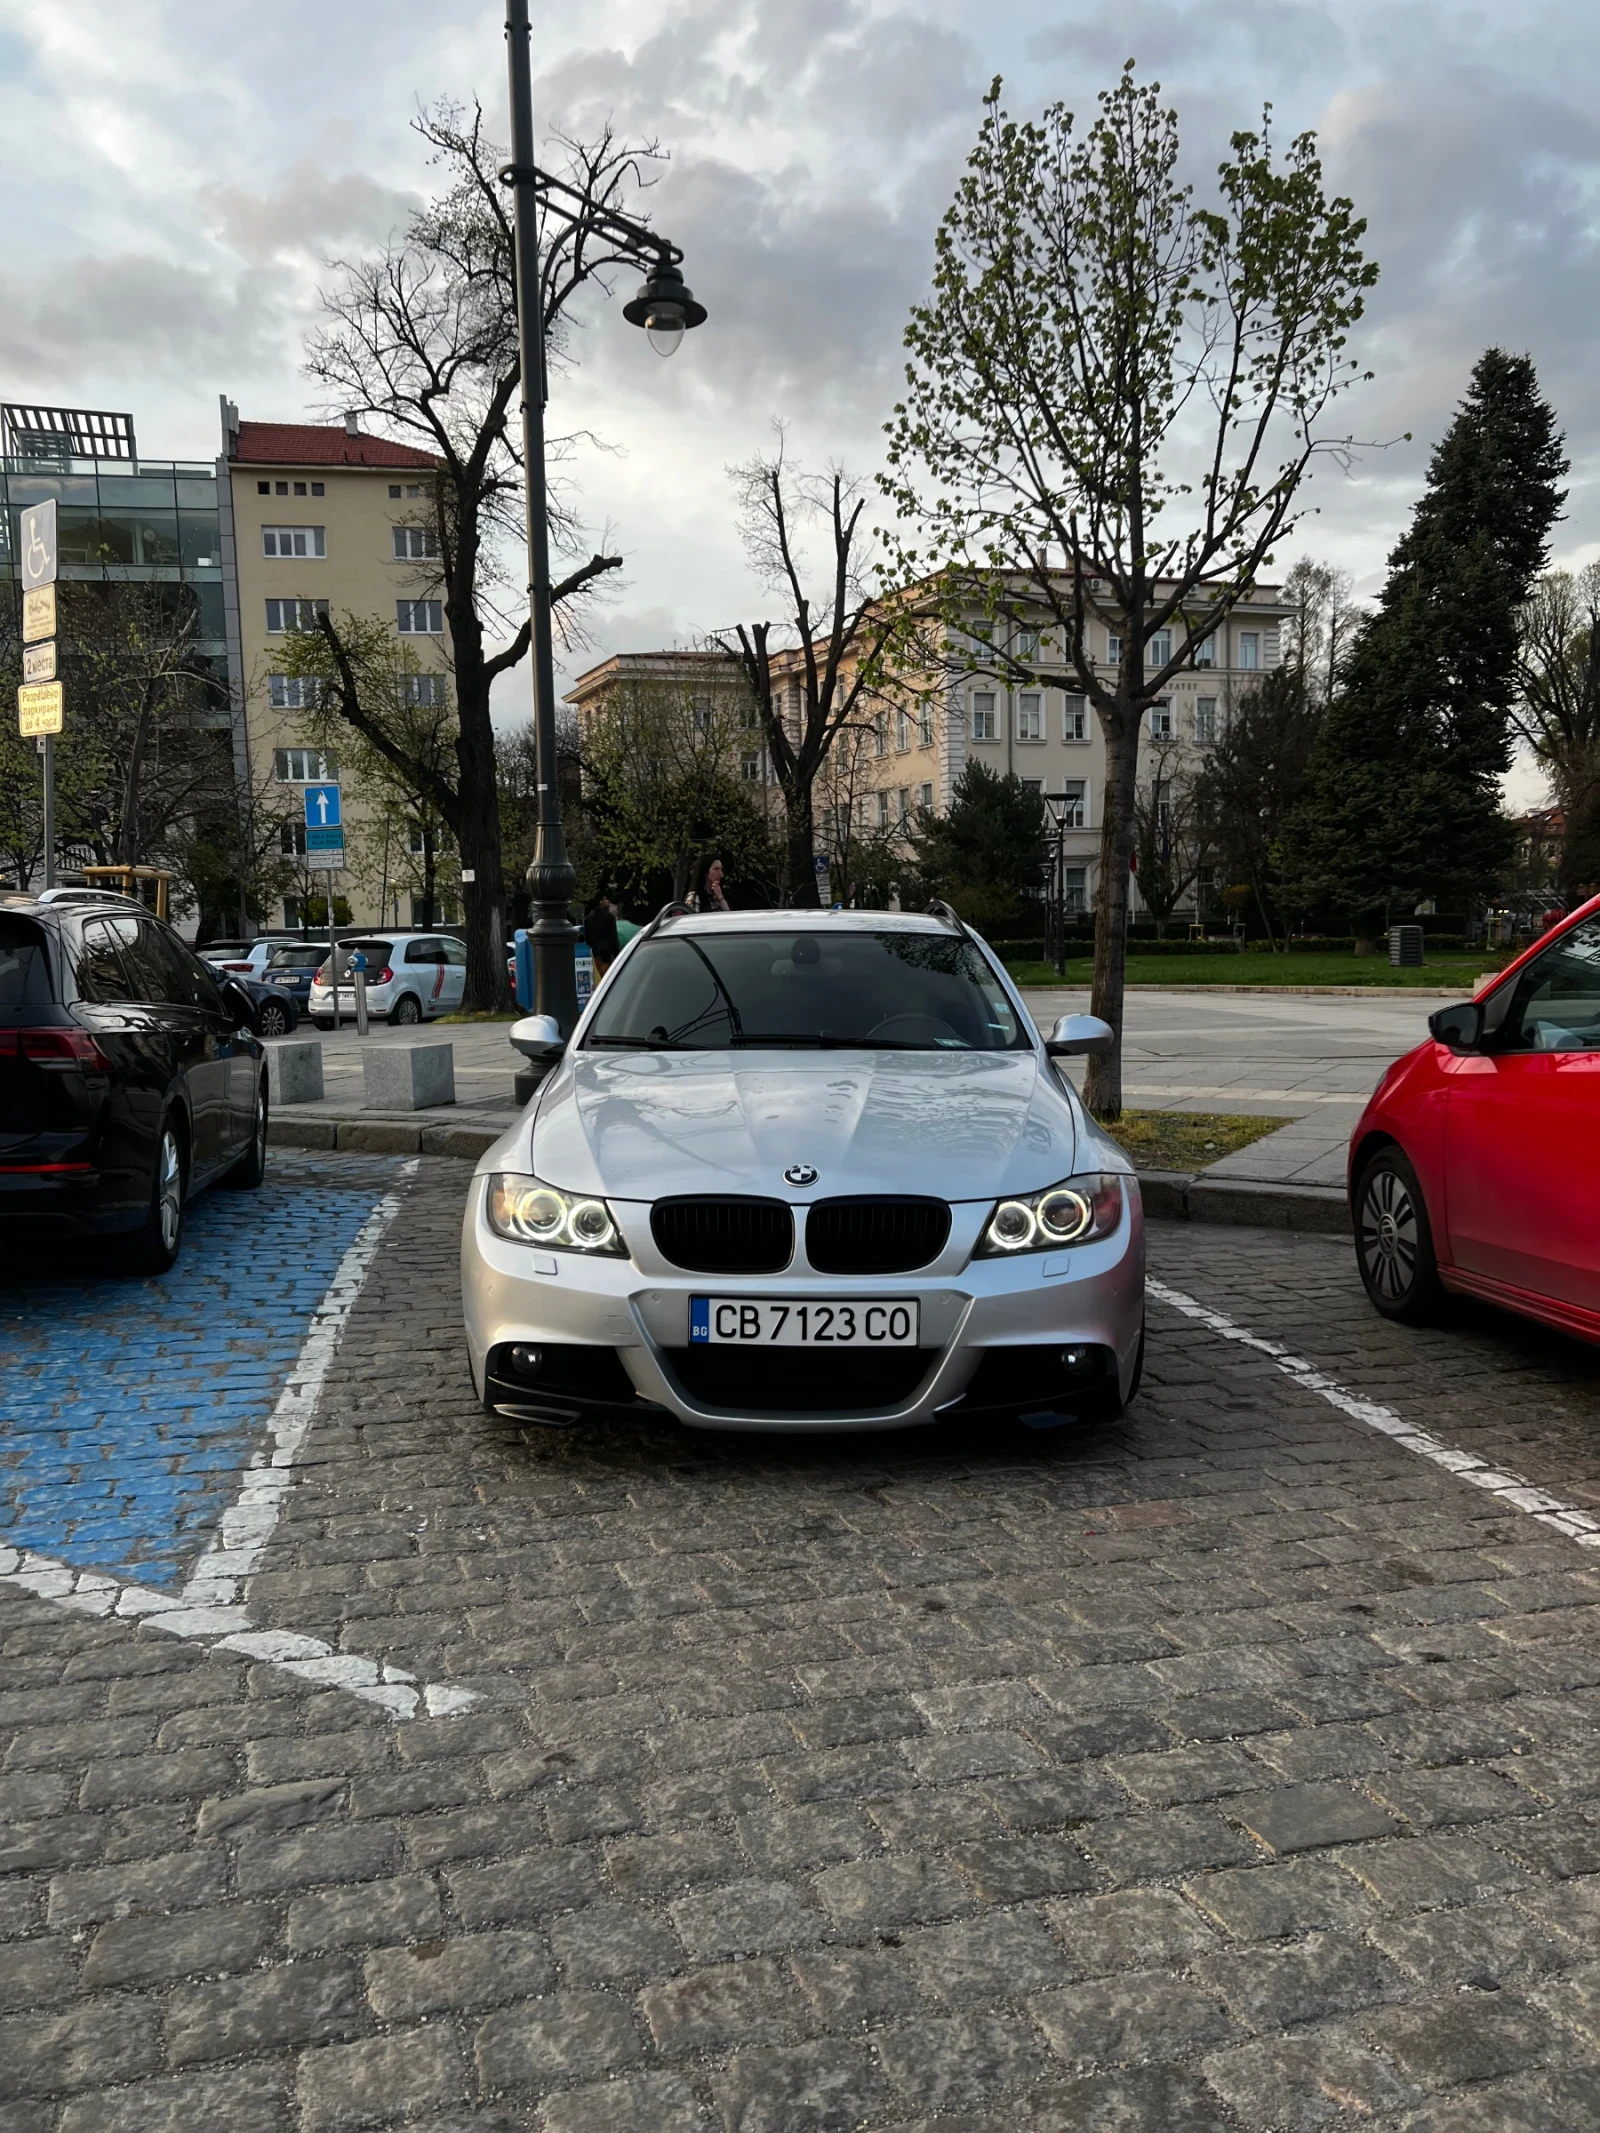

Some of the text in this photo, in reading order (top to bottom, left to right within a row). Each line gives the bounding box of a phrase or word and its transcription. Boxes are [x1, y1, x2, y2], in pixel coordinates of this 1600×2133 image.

[27, 657, 52, 675] 2 места
[22, 689, 59, 703] Разрешено
[23, 704, 58, 718] паркиране
[693, 1326, 708, 1337] BG
